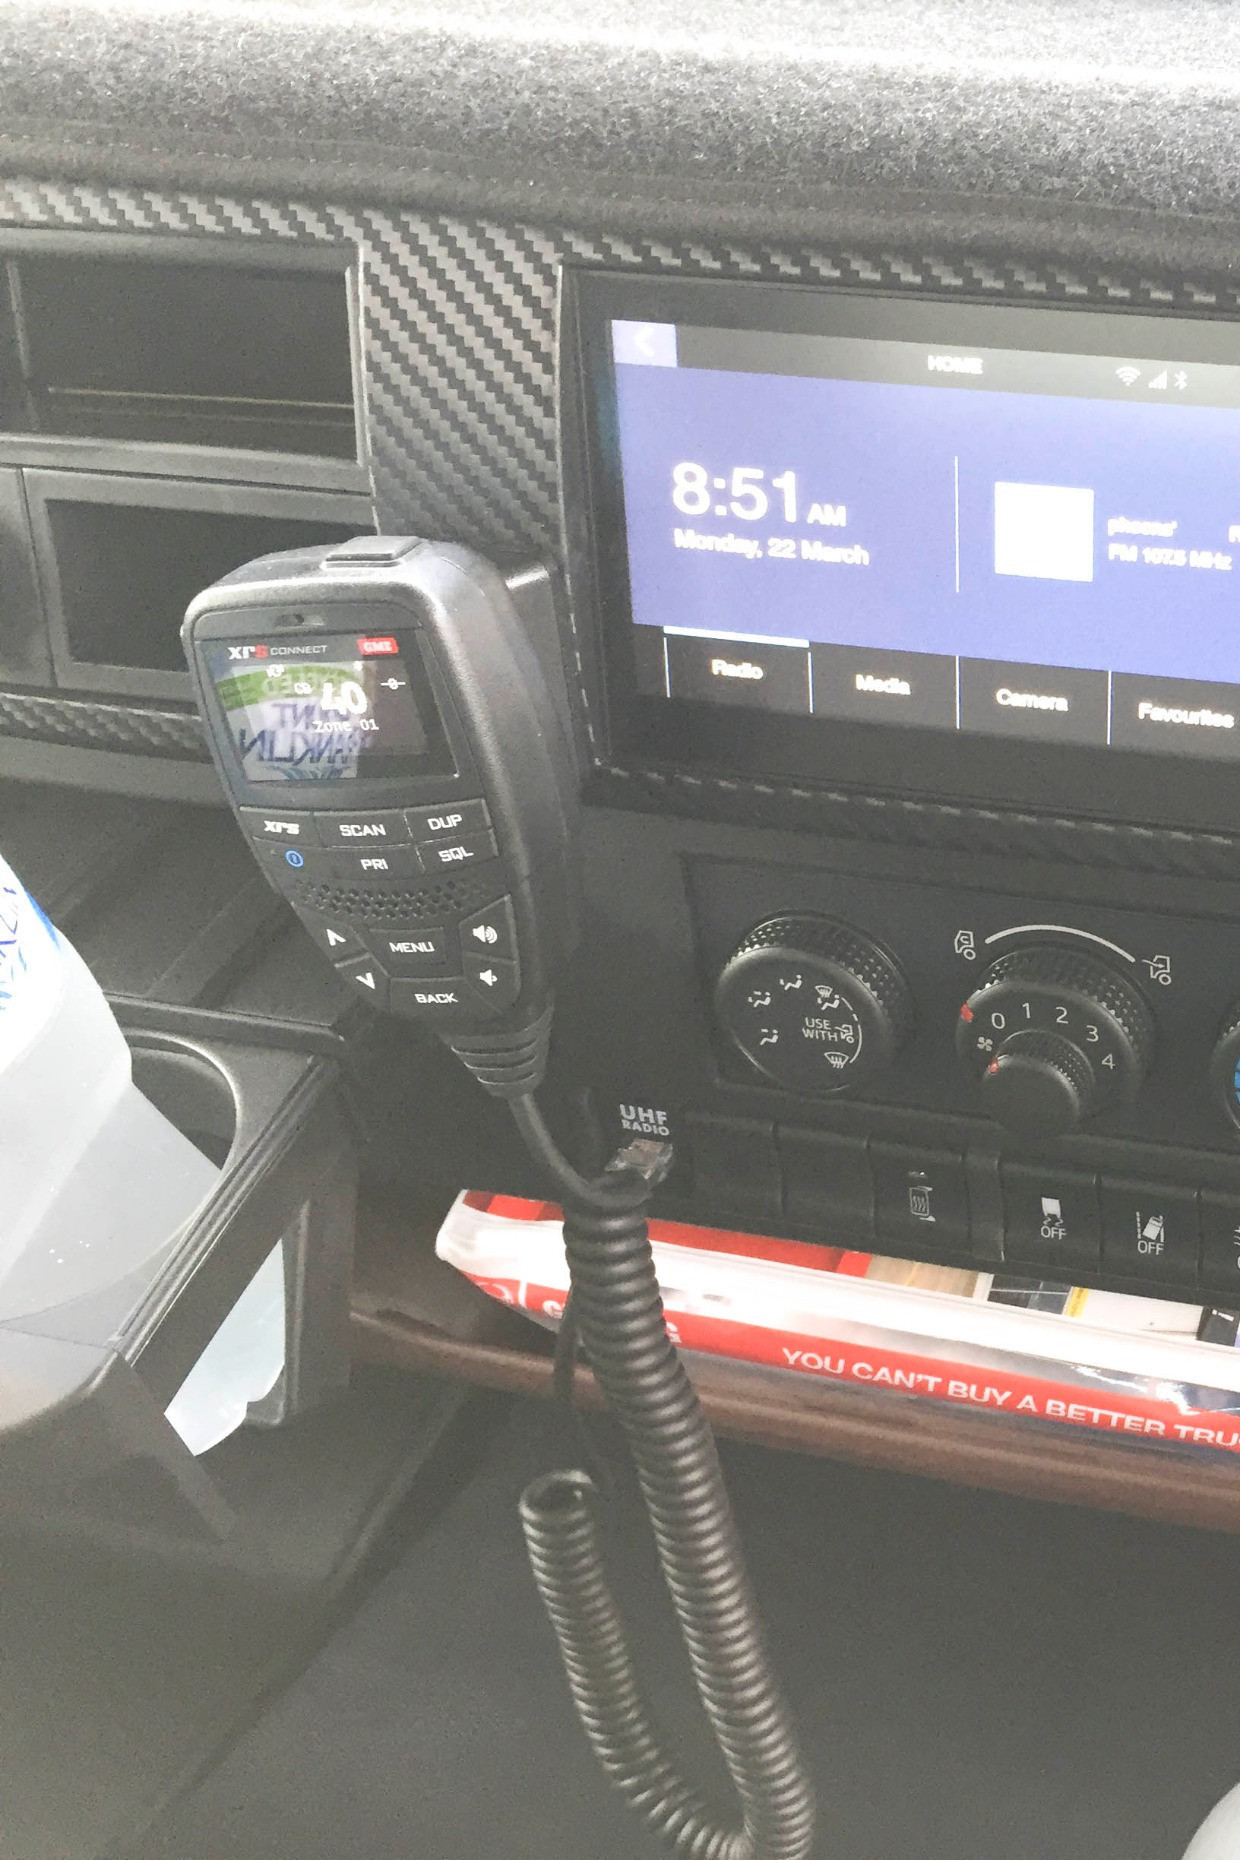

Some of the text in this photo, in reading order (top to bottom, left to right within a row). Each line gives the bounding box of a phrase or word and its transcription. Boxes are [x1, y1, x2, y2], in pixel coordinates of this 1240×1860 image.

[928, 355, 984, 375] HOME
[672, 462, 847, 527] 8:51 AM
[768, 537, 797, 559] 22
[801, 540, 870, 566] March
[1108, 543, 1138, 563] FM
[270, 644, 328, 657] CONNECT
[711, 658, 764, 681] Radio
[855, 674, 912, 696] Media
[996, 687, 1069, 712] Camera
[1138, 702, 1235, 730] Favourites
[339, 823, 387, 837] SCAN
[427, 813, 463, 831] DUP
[438, 846, 474, 862] SQL
[360, 858, 389, 871] PRI
[389, 941, 435, 954] MENU
[414, 992, 459, 1005] BACK
[1021, 1002, 1032, 1019] 1
[1055, 1006, 1069, 1024] 2
[804, 1016, 832, 1031] USE
[991, 1012, 1006, 1030] 0
[802, 1027, 838, 1042] WITH
[1085, 1025, 1099, 1042] 3
[1101, 1053, 1116, 1070] 4
[619, 1103, 668, 1126] UHF
[621, 1119, 670, 1136] RADIO
[1040, 1225, 1067, 1240] OFF
[1137, 1240, 1165, 1256] OFF
[781, 1347, 845, 1375] YOU
[851, 1361, 943, 1393] CAN'T
[947, 1379, 1013, 1406] BUY
[1016, 1394, 1039, 1413] A
[1045, 1400, 1167, 1434] BETTER
